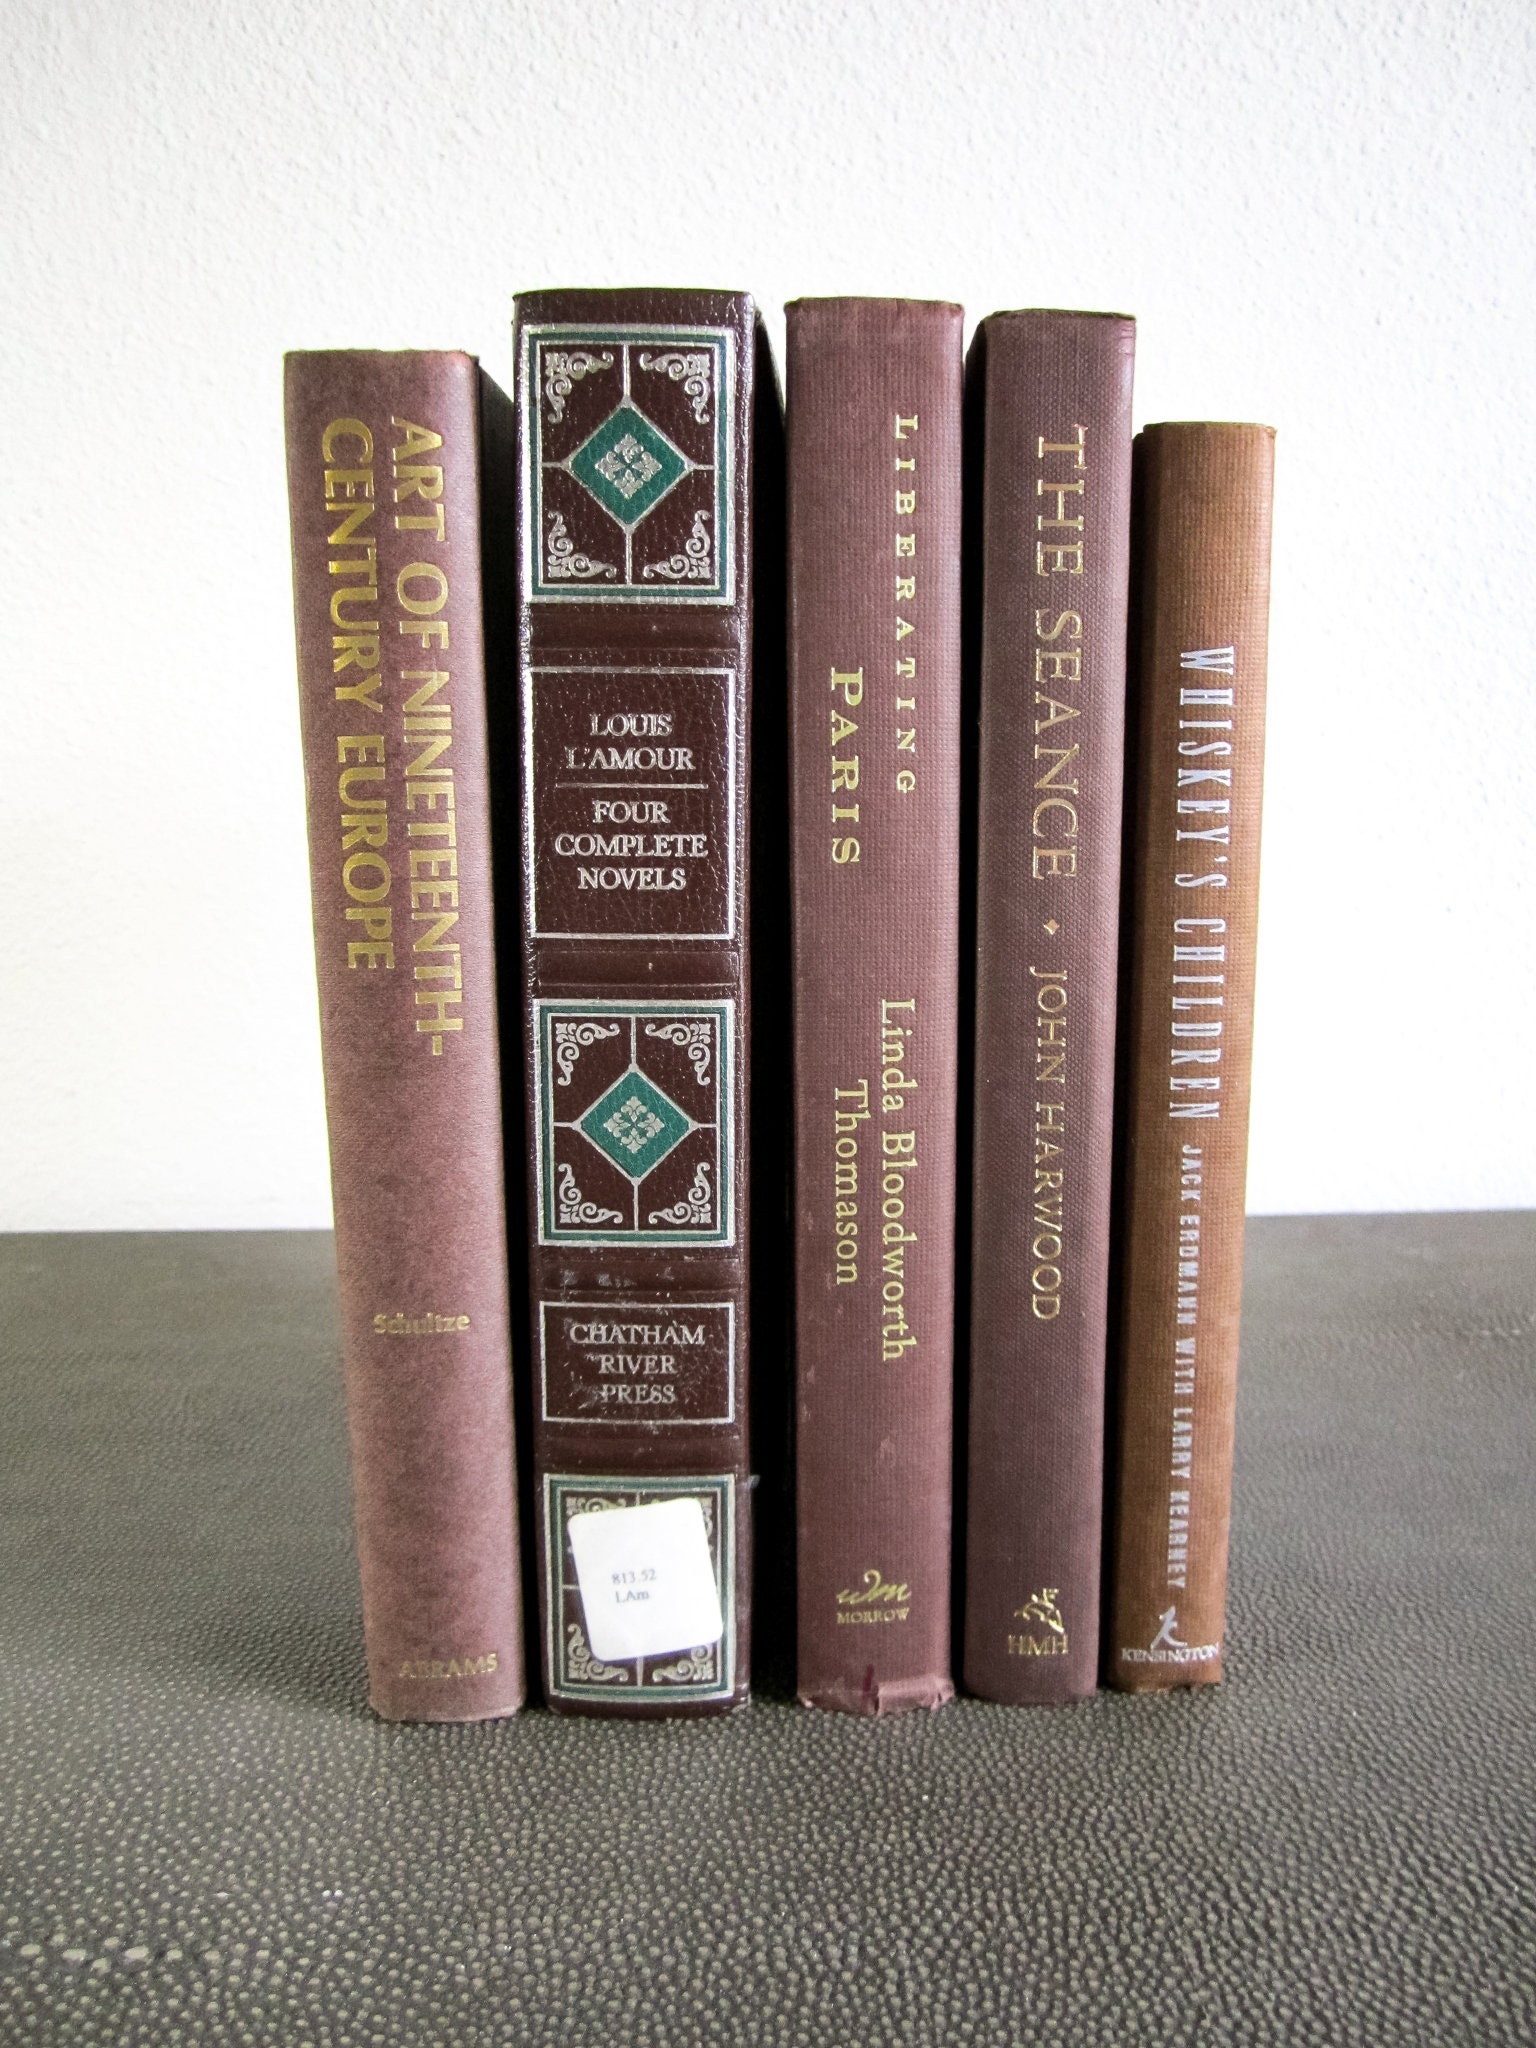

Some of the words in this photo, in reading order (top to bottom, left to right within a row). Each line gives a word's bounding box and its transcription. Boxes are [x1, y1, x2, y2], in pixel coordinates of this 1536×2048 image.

[392, 415, 446, 542] ART
[1036, 423, 1089, 578] THE
[321, 417, 383, 713] CENTURY
[396, 561, 449, 650] OF
[895, 414, 919, 794] LIBERATING
[564, 746, 696, 771] L'AMOUR
[589, 712, 673, 737] LOUIS
[831, 667, 864, 864] PARIS
[1032, 608, 1083, 880] SEANCE
[1174, 645, 1235, 888] WHISKEY'S
[336, 735, 395, 970] EUROPE
[554, 833, 709, 858] COMPLETE
[592, 800, 671, 824] FOUR
[400, 670, 464, 1057] NINETEENTH-
[577, 867, 687, 891] NOVELS
[881, 998, 918, 1113] Linda
[1029, 965, 1068, 1083] JOHN
[1168, 917, 1227, 1119] CHILDREN
[834, 1079, 872, 1286] Thomason
[1032, 1101, 1065, 1321] HARWOOD
[1180, 1144, 1202, 1201] JACK
[882, 1130, 918, 1362] Bloodworth
[1176, 1214, 1200, 1325] ERDMANN
[373, 1312, 471, 1334] Schultze
[569, 1324, 706, 1346] CHATHAM
[598, 1354, 678, 1375] RIVER
[1174, 1337, 1196, 1394] WITH
[601, 1384, 676, 1405] PRESS
[1170, 1408, 1193, 1479] LARRY
[1167, 1491, 1190, 1589] KEARNEY
[836, 1607, 910, 1625] MORROW
[1008, 1634, 1069, 1656] HMH
[1121, 1642, 1219, 1663] KENSINGTON
[399, 1652, 498, 1678] ABRAMS
